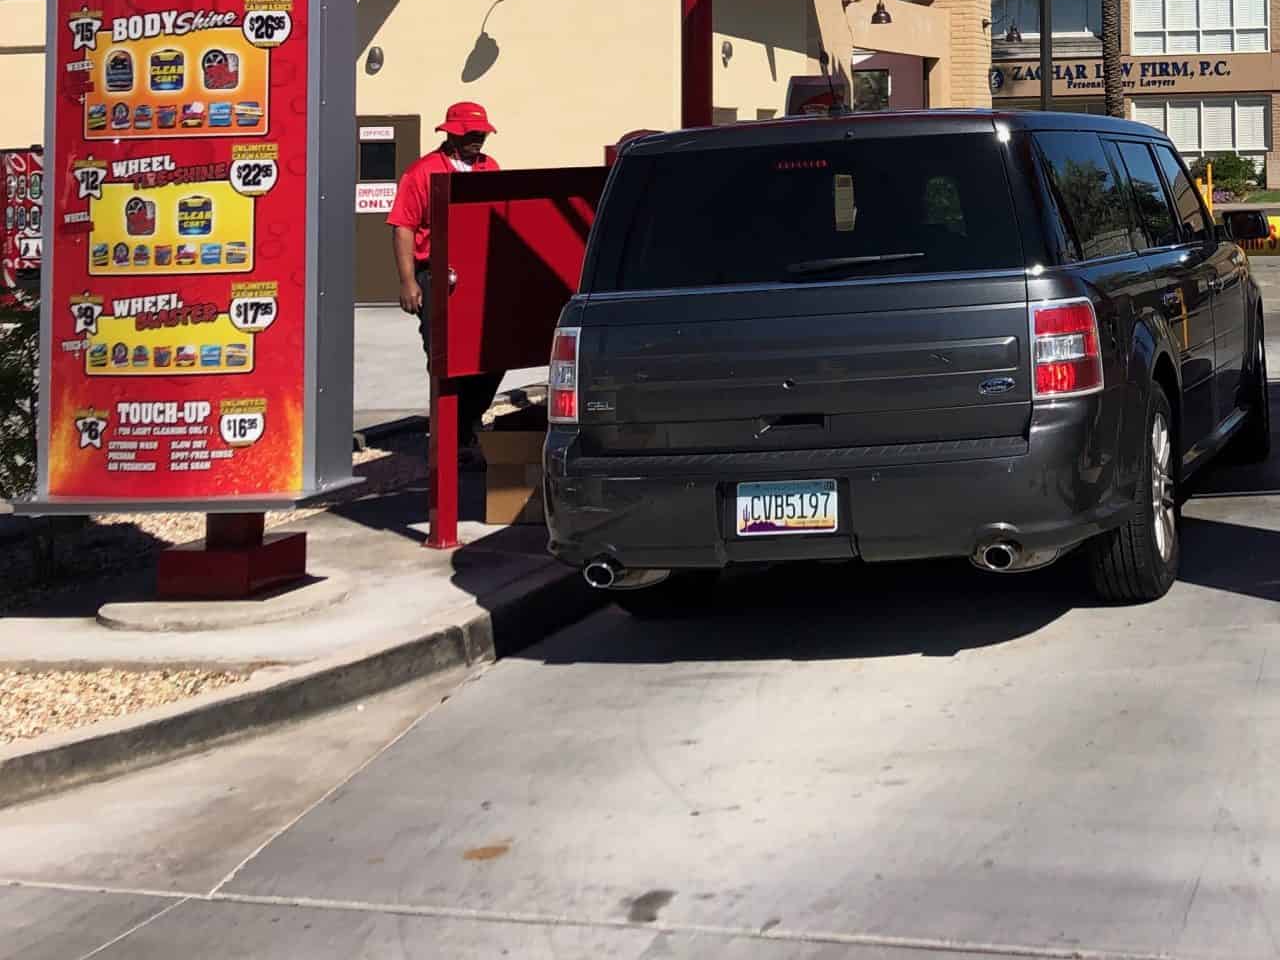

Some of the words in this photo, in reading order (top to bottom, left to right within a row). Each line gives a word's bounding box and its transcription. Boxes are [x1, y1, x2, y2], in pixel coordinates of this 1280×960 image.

[112, 11, 176, 42] BODY
[174, 10, 236, 34] Shine
[1095, 62, 1132, 78] LW
[1141, 61, 1194, 78] FIRM,
[1200, 60, 1231, 76] P.C.
[111, 155, 175, 177] WHEEL
[80, 171, 99, 191] $12
[358, 199, 393, 209] ONLY
[77, 306, 94, 326] $9
[112, 293, 183, 317] WHEEL
[117, 401, 211, 424] TOUCH-UP
[751, 493, 830, 520] CVB5197
